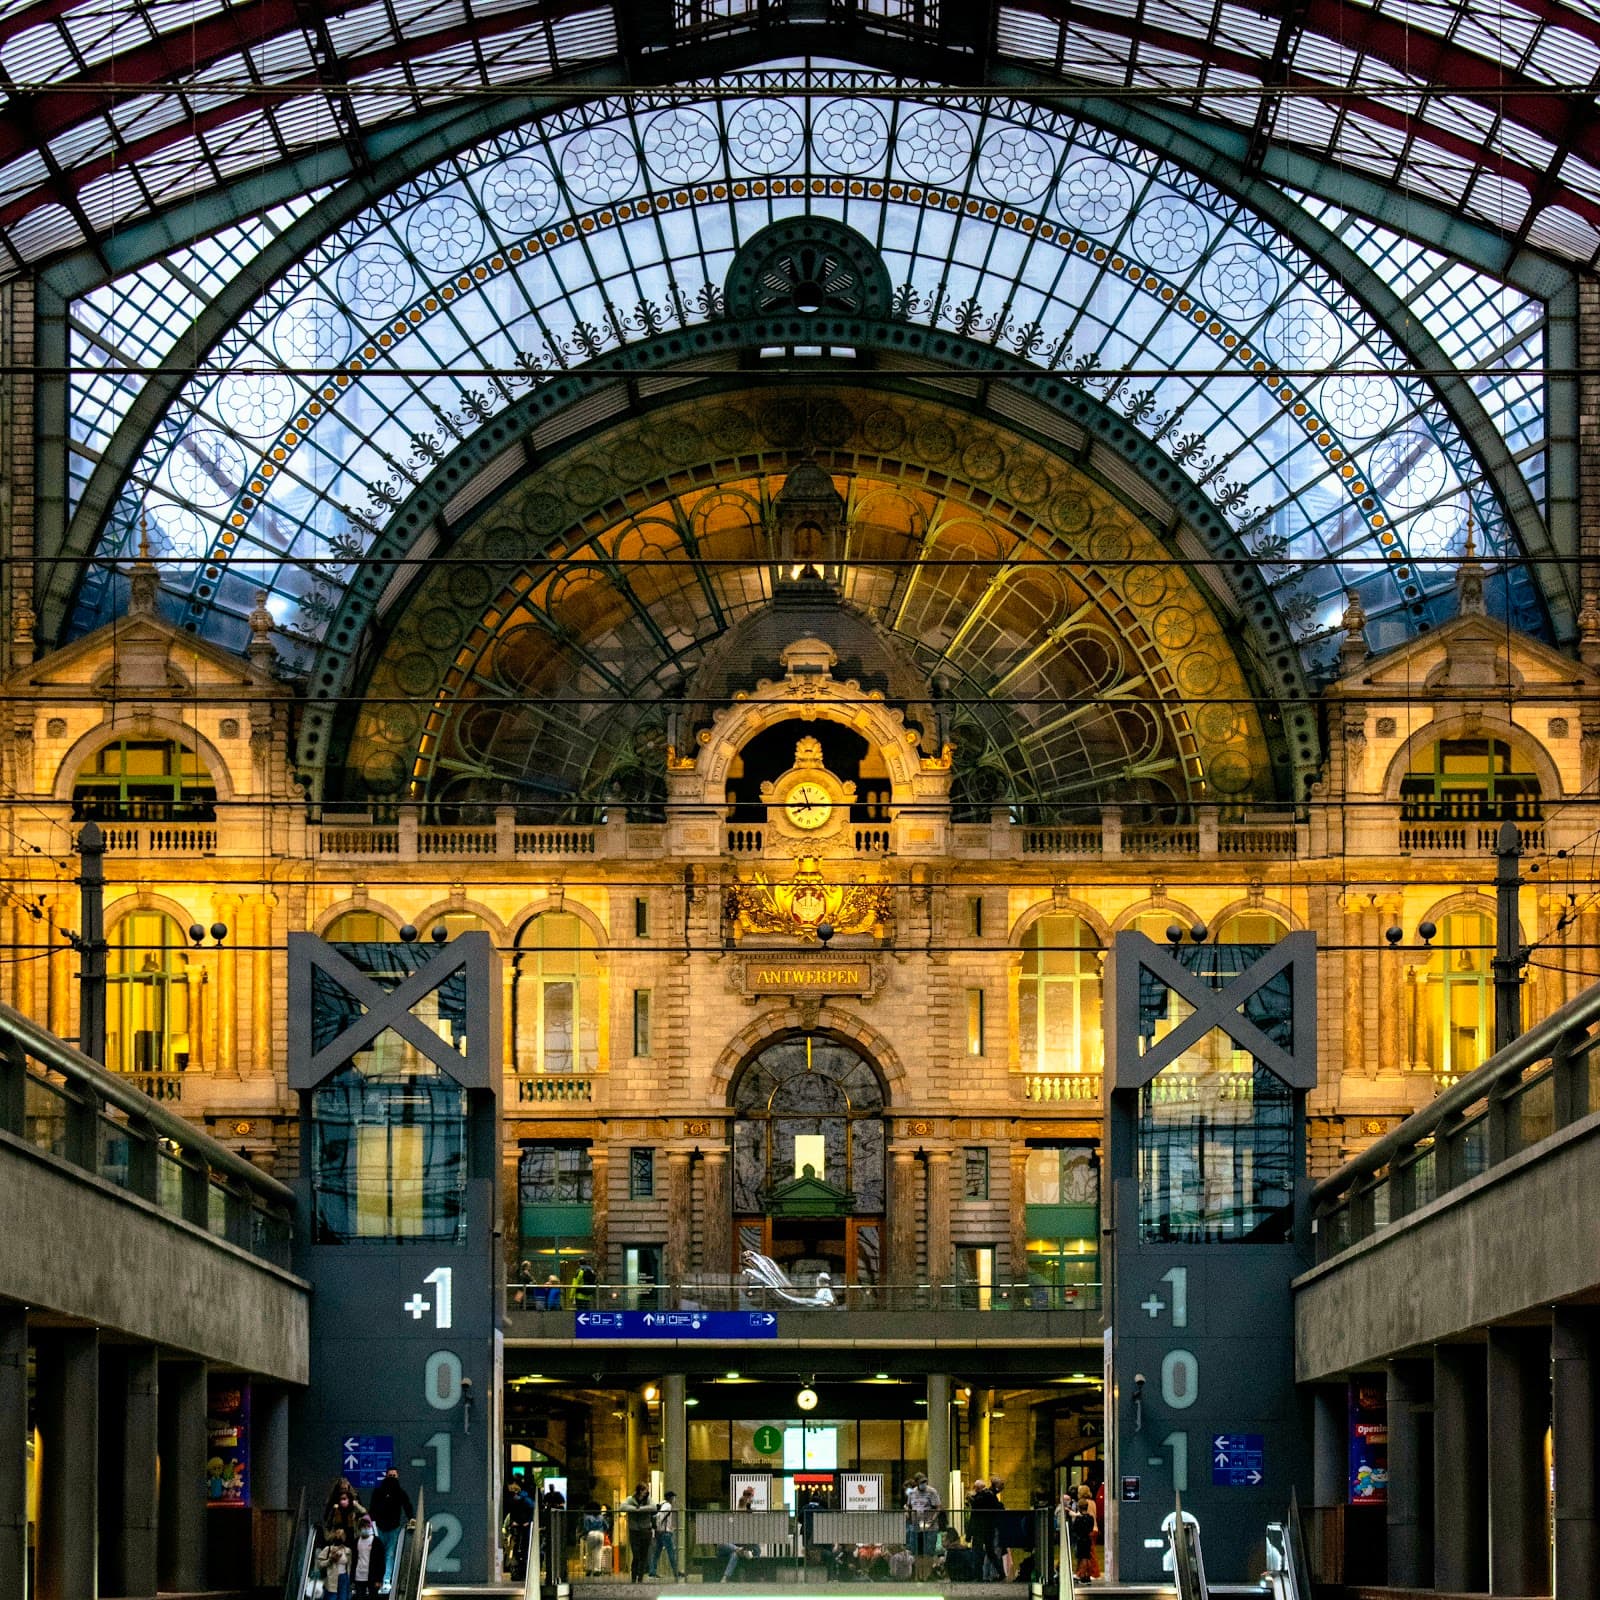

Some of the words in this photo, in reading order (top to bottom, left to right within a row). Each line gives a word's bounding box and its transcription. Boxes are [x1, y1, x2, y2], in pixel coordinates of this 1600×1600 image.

[757, 970, 858, 984] ANTWERPEN
[403, 1266, 453, 1329] +1
[1141, 1266, 1188, 1328] +1
[424, 1350, 463, 1411] 0
[1161, 1348, 1199, 1409] 0
[410, 1432, 452, 1493] -1
[1148, 1431, 1188, 1491] -1
